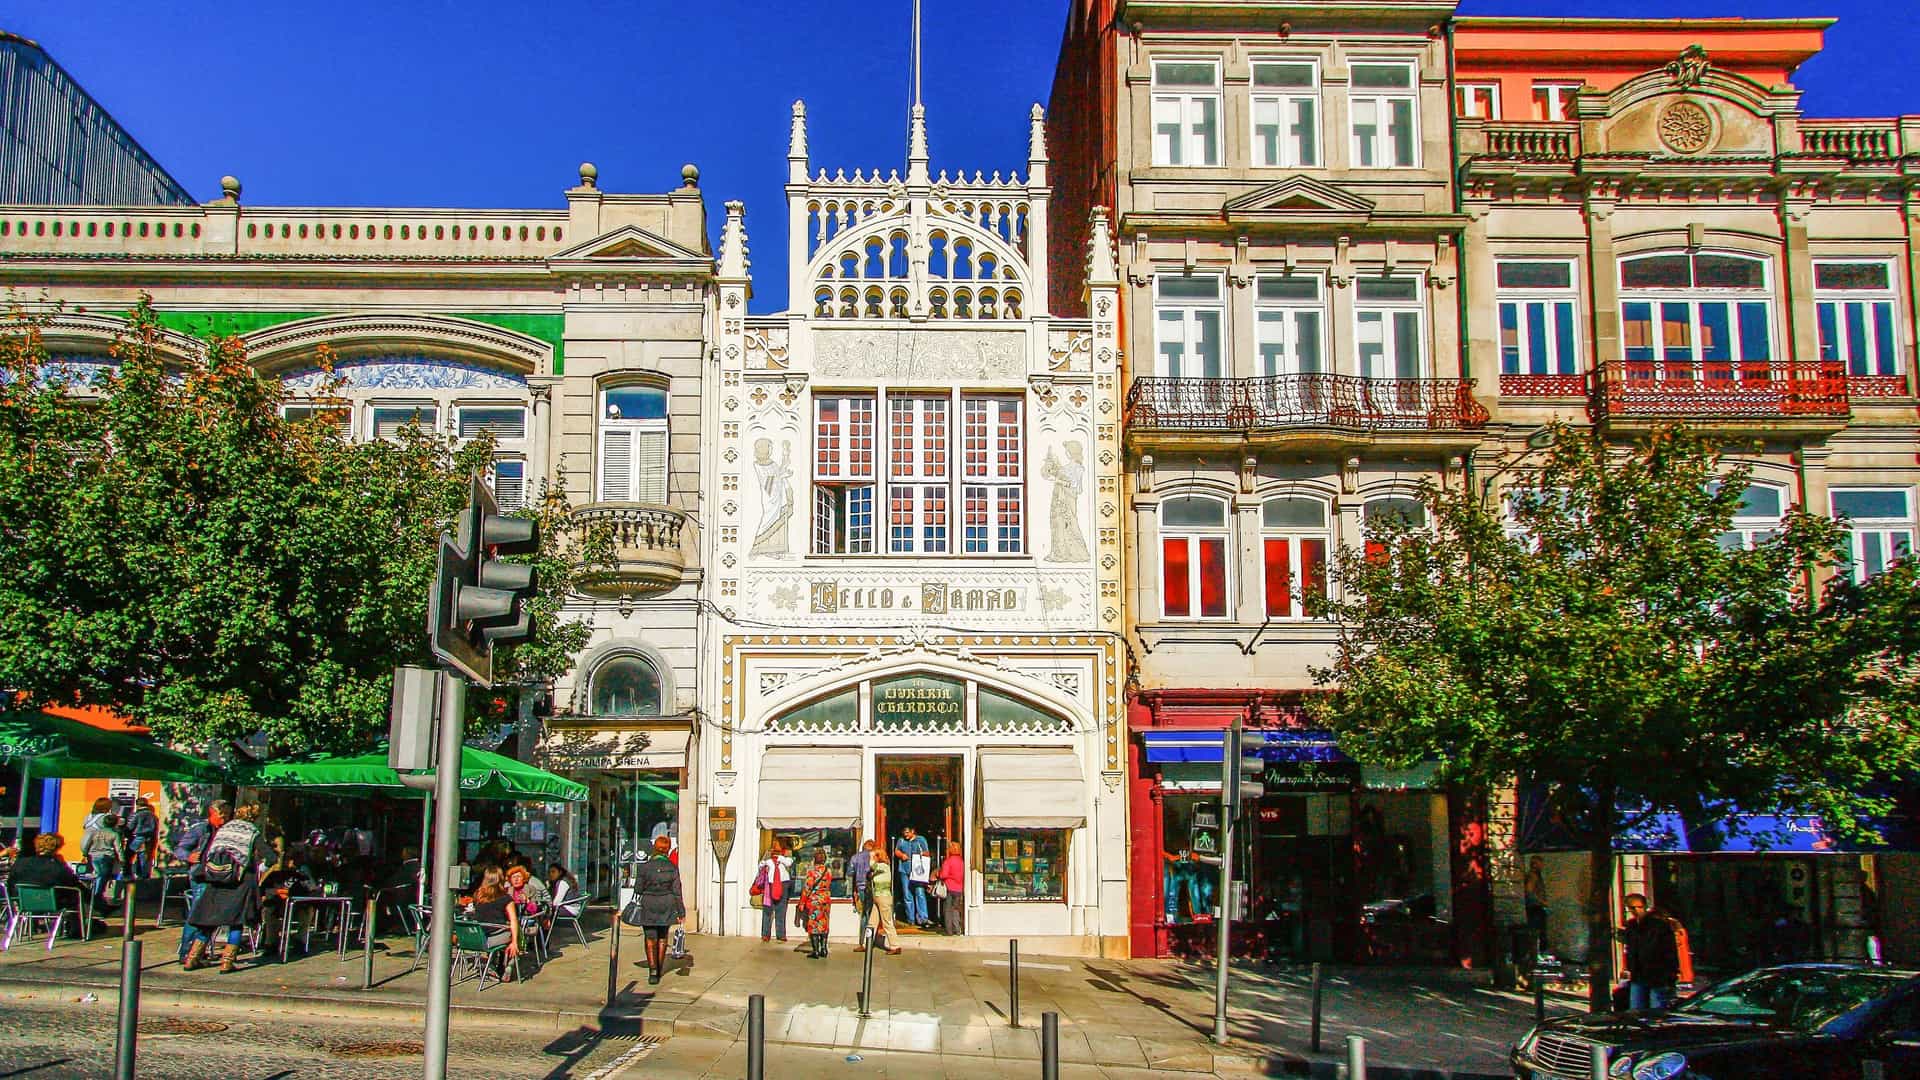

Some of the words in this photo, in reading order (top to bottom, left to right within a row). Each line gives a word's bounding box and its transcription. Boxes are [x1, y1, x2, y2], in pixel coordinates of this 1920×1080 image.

[810, 583, 894, 613] LELLO
[901, 596, 912, 608] &
[877, 701, 959, 714] CHARDRON
